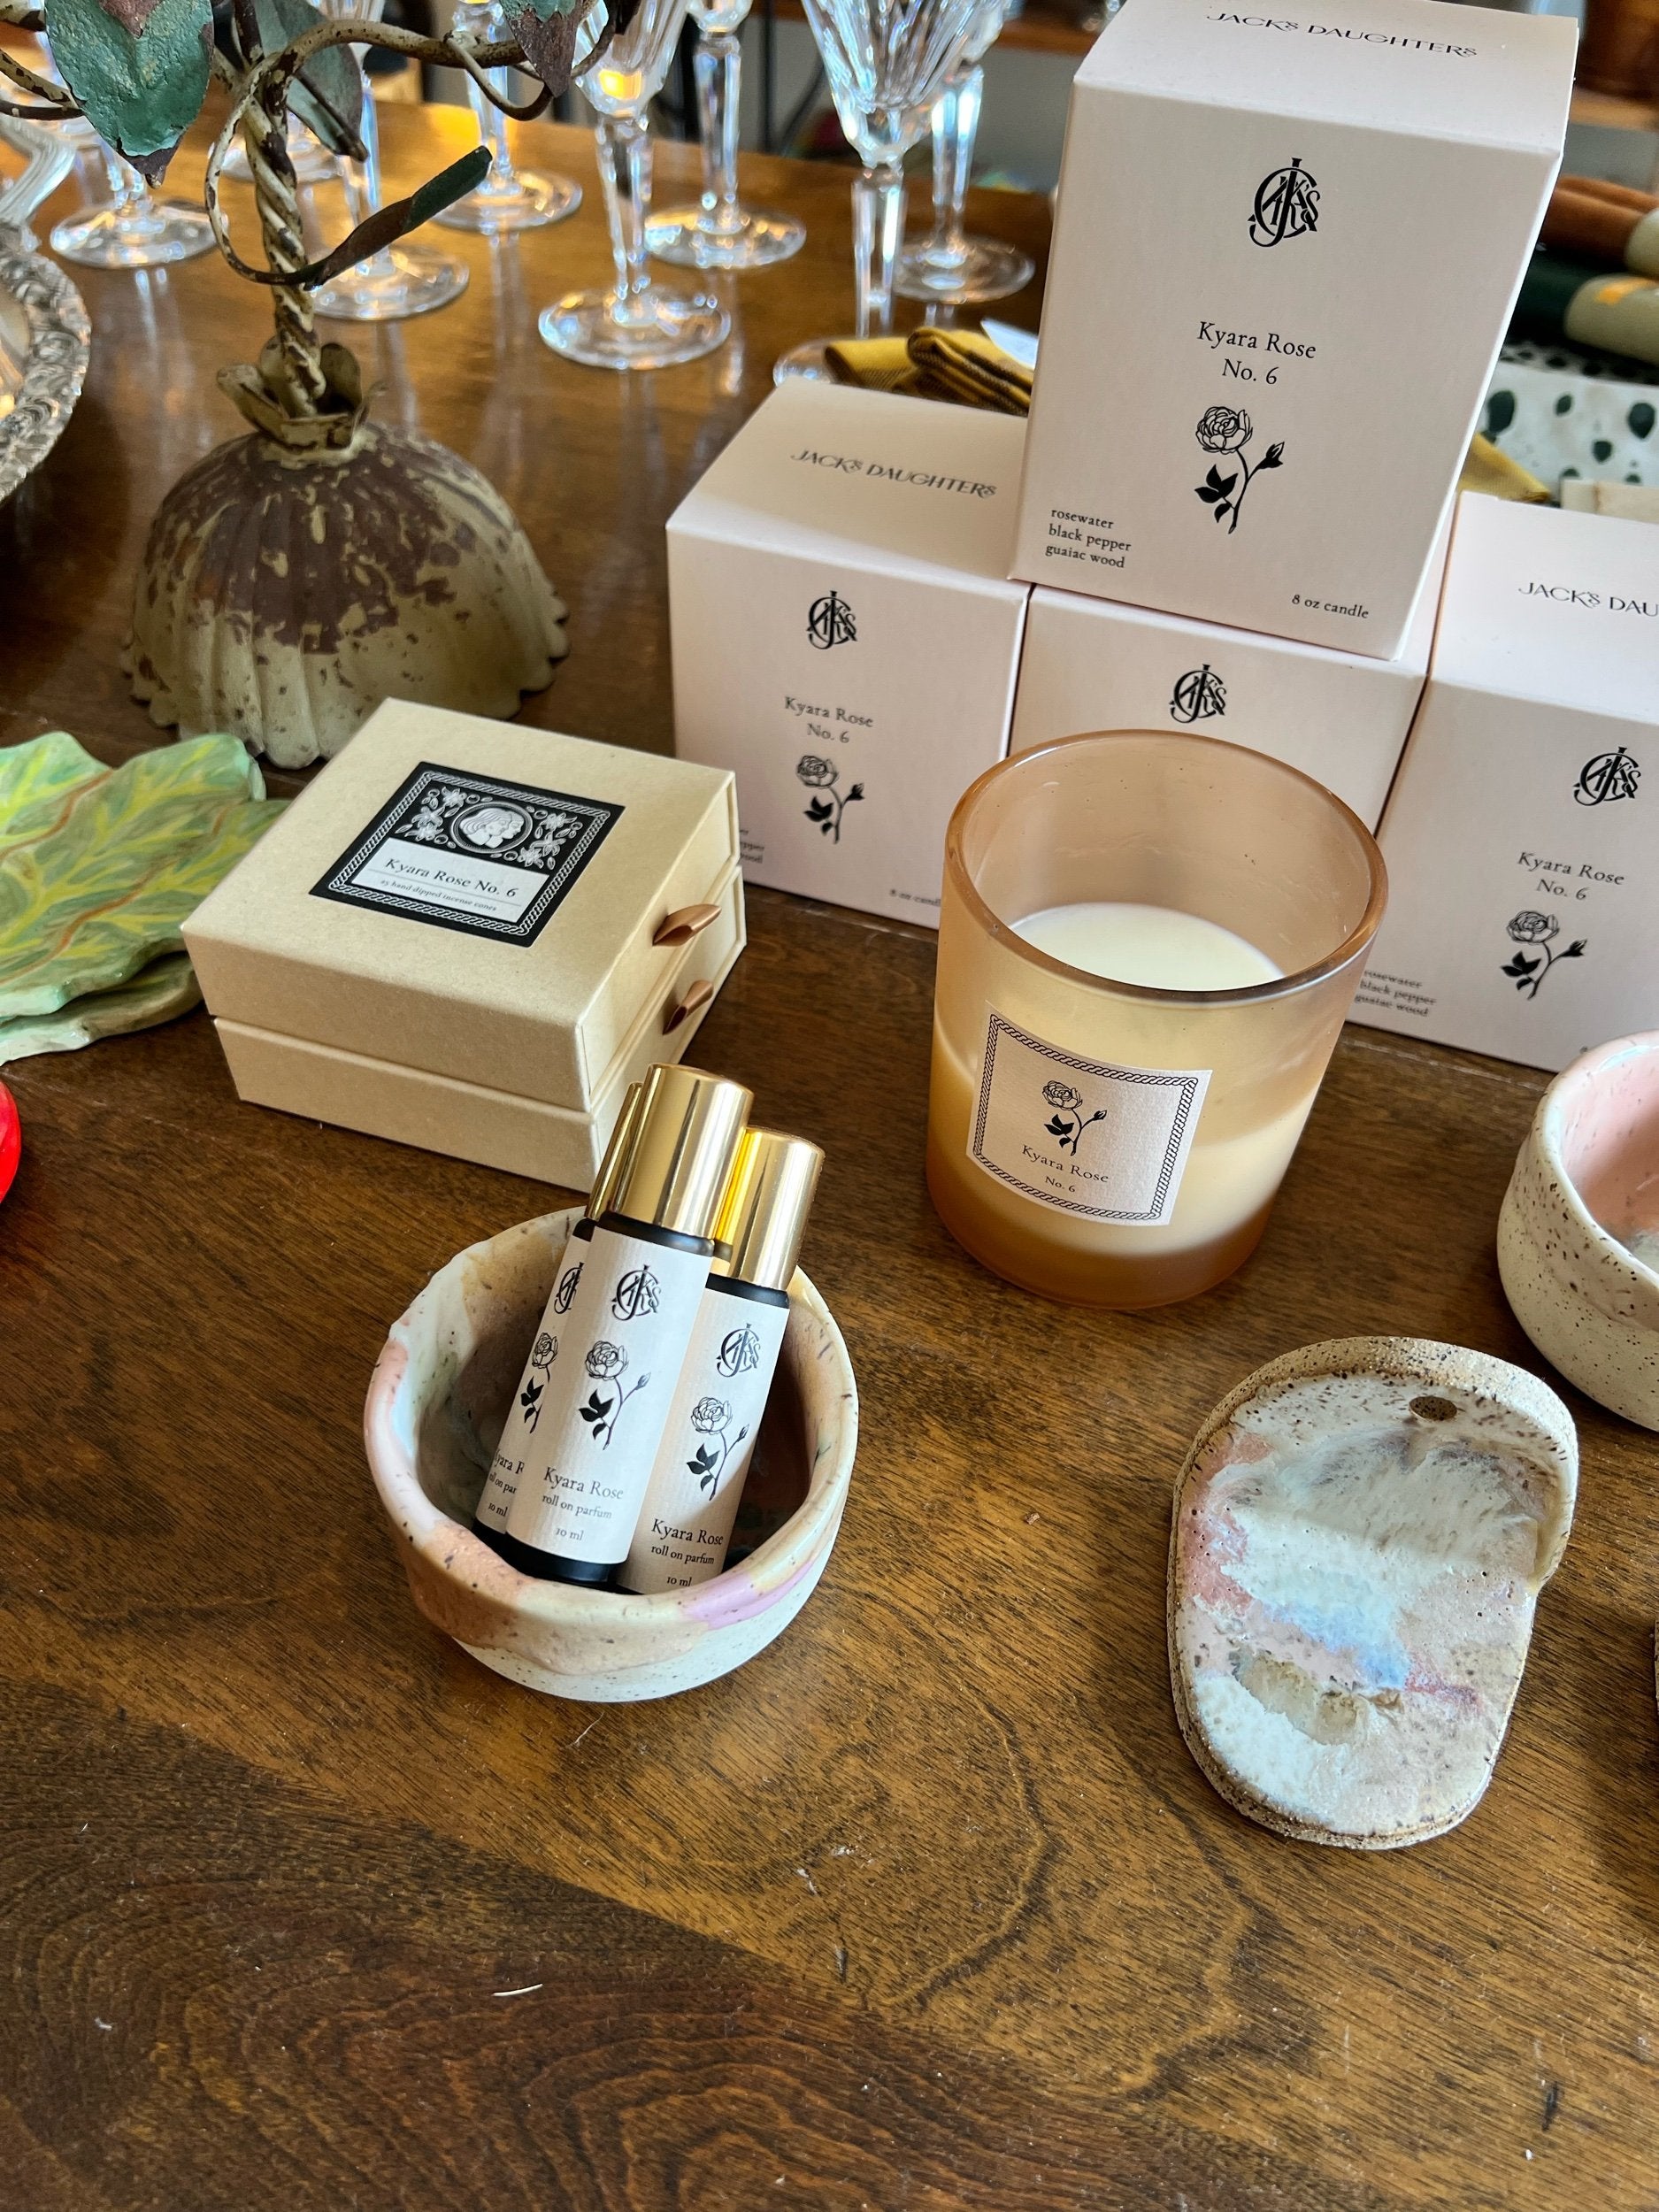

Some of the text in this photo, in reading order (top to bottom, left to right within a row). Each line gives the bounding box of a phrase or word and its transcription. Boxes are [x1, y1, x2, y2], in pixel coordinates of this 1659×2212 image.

[1308, 25, 1478, 58] DAUGHTERS
[1197, 320, 1316, 358] Kyara Rose
[1222, 358, 1279, 384] No. 6
[865, 464, 997, 499] DAUGHTERS
[1051, 509, 1115, 529] rosewater
[1048, 523, 1132, 551] black pepper
[1045, 545, 1125, 568] guaiac wood
[1292, 594, 1369, 618] 8 oz candle
[784, 696, 873, 727] Kyara Rose
[807, 723, 850, 743] No. 6
[385, 858, 519, 897] Kyara Rose No. 6
[1517, 851, 1624, 885] Kyara Rose
[391, 879, 412, 891] hand
[412, 887, 442, 899] dipped
[442, 894, 472, 906] incense
[473, 902, 497, 911] cones
[1536, 879, 1591, 900] No. 6
[1021, 1144, 1109, 1183] Kyara Rose
[1045, 1175, 1077, 1194] No. 6
[495, 1479, 503, 1488] on
[543, 1466, 624, 1500] Kyara Rose
[496, 1506, 509, 1517] ml
[541, 1494, 613, 1519] roll on parfum
[571, 1529, 584, 1541] ml
[651, 1517, 724, 1546] Kyara Rose
[651, 1545, 715, 1564] roll on parfum
[679, 1576, 693, 1587] ml
